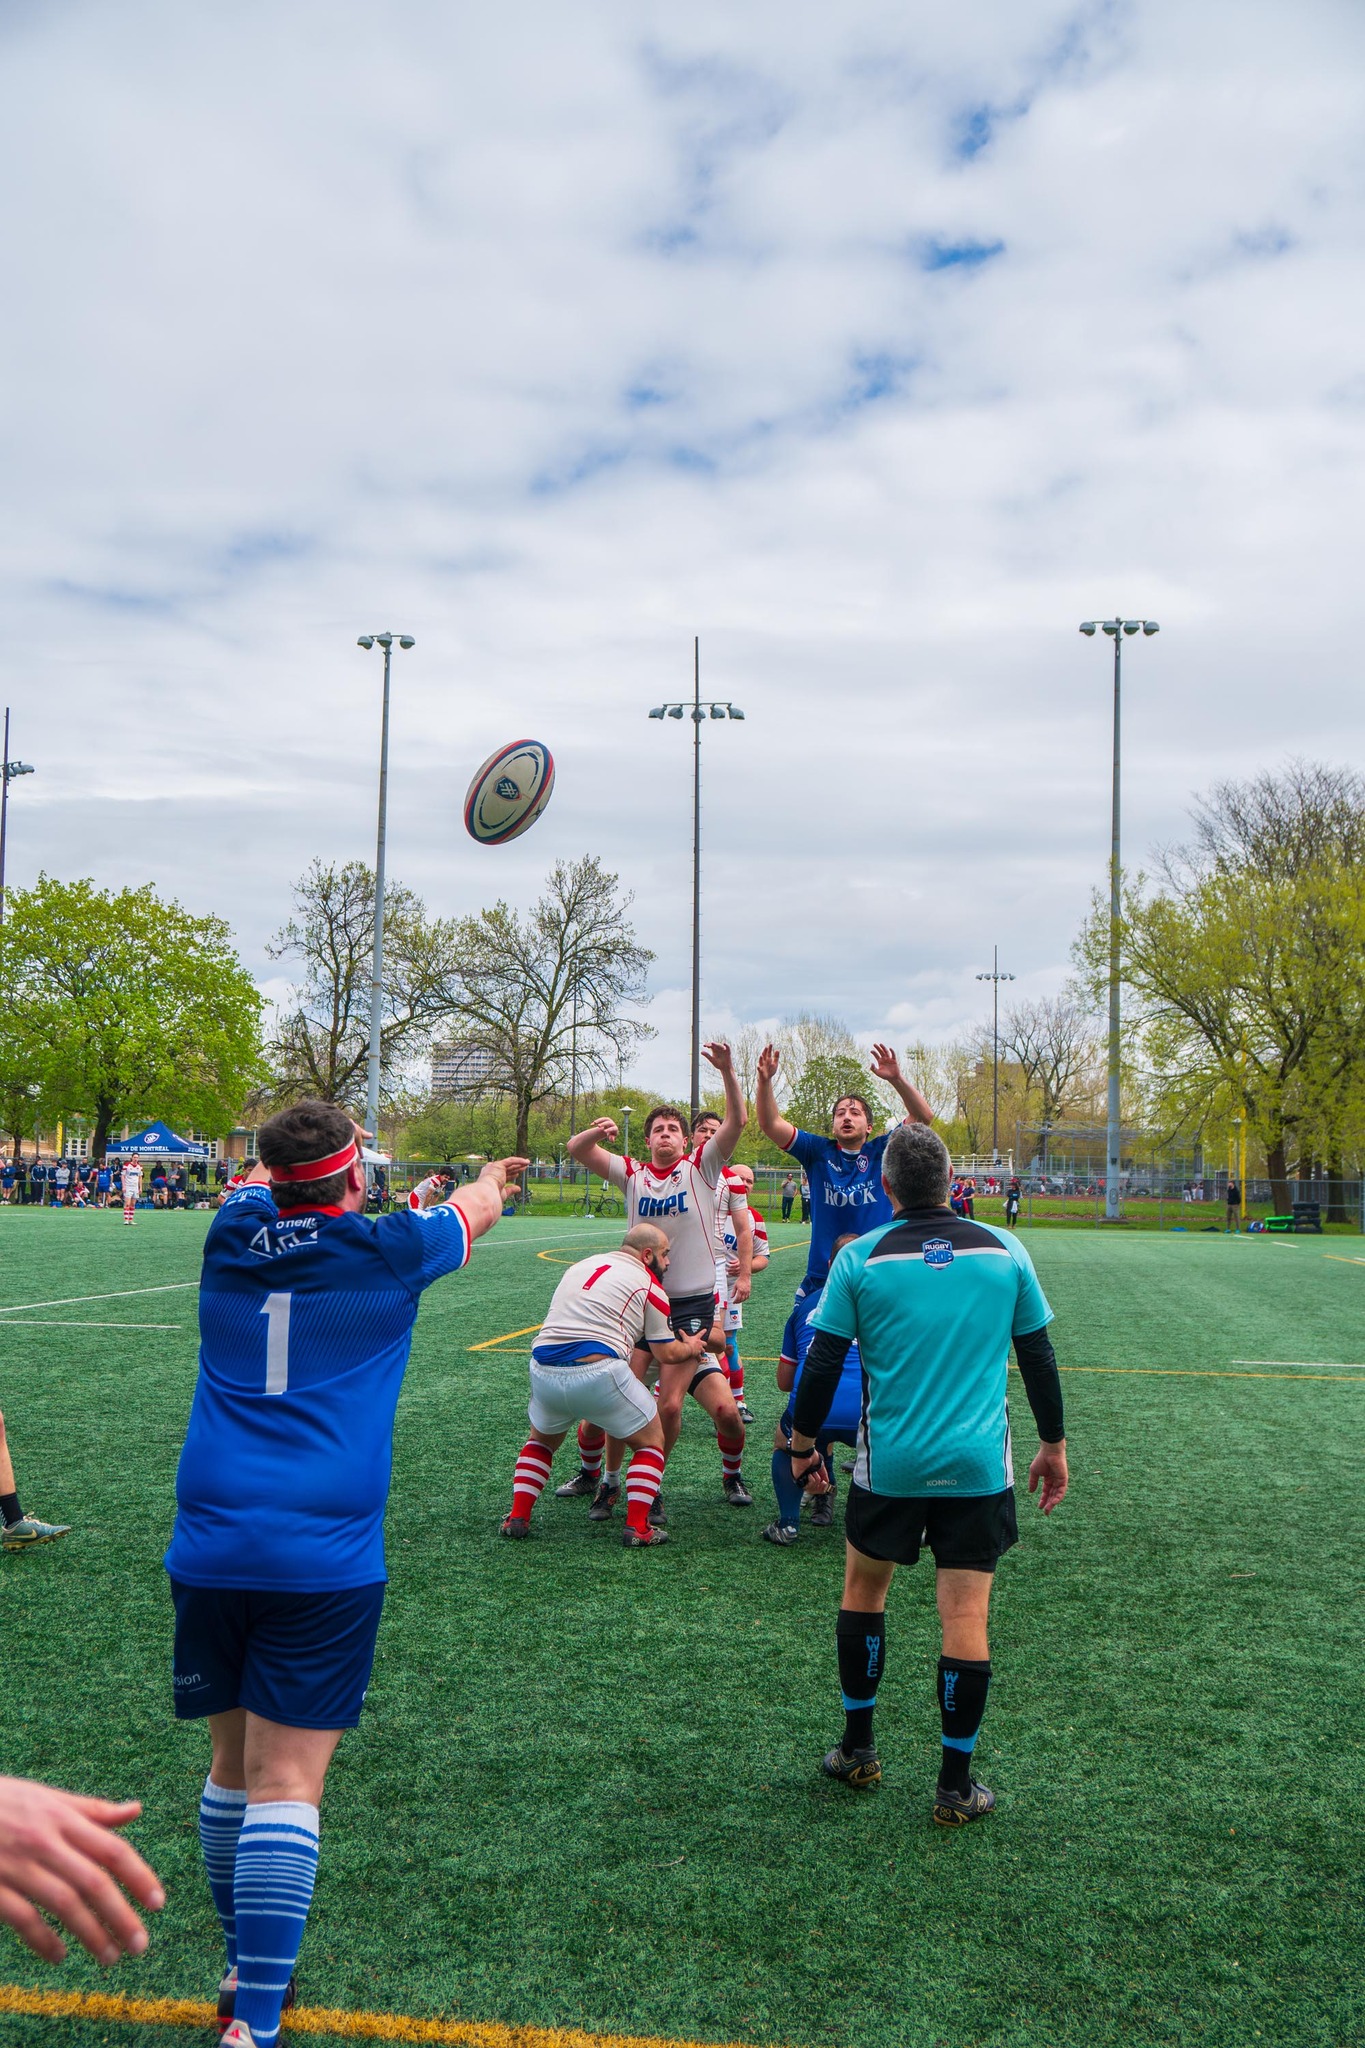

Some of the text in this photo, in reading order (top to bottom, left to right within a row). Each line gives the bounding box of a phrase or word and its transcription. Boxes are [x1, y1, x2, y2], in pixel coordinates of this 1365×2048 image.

[824, 1186, 878, 1207] ROCK
[582, 1264, 612, 1291] 1
[259, 1292, 292, 1395] 1
[926, 1479, 958, 1487] KONNO
